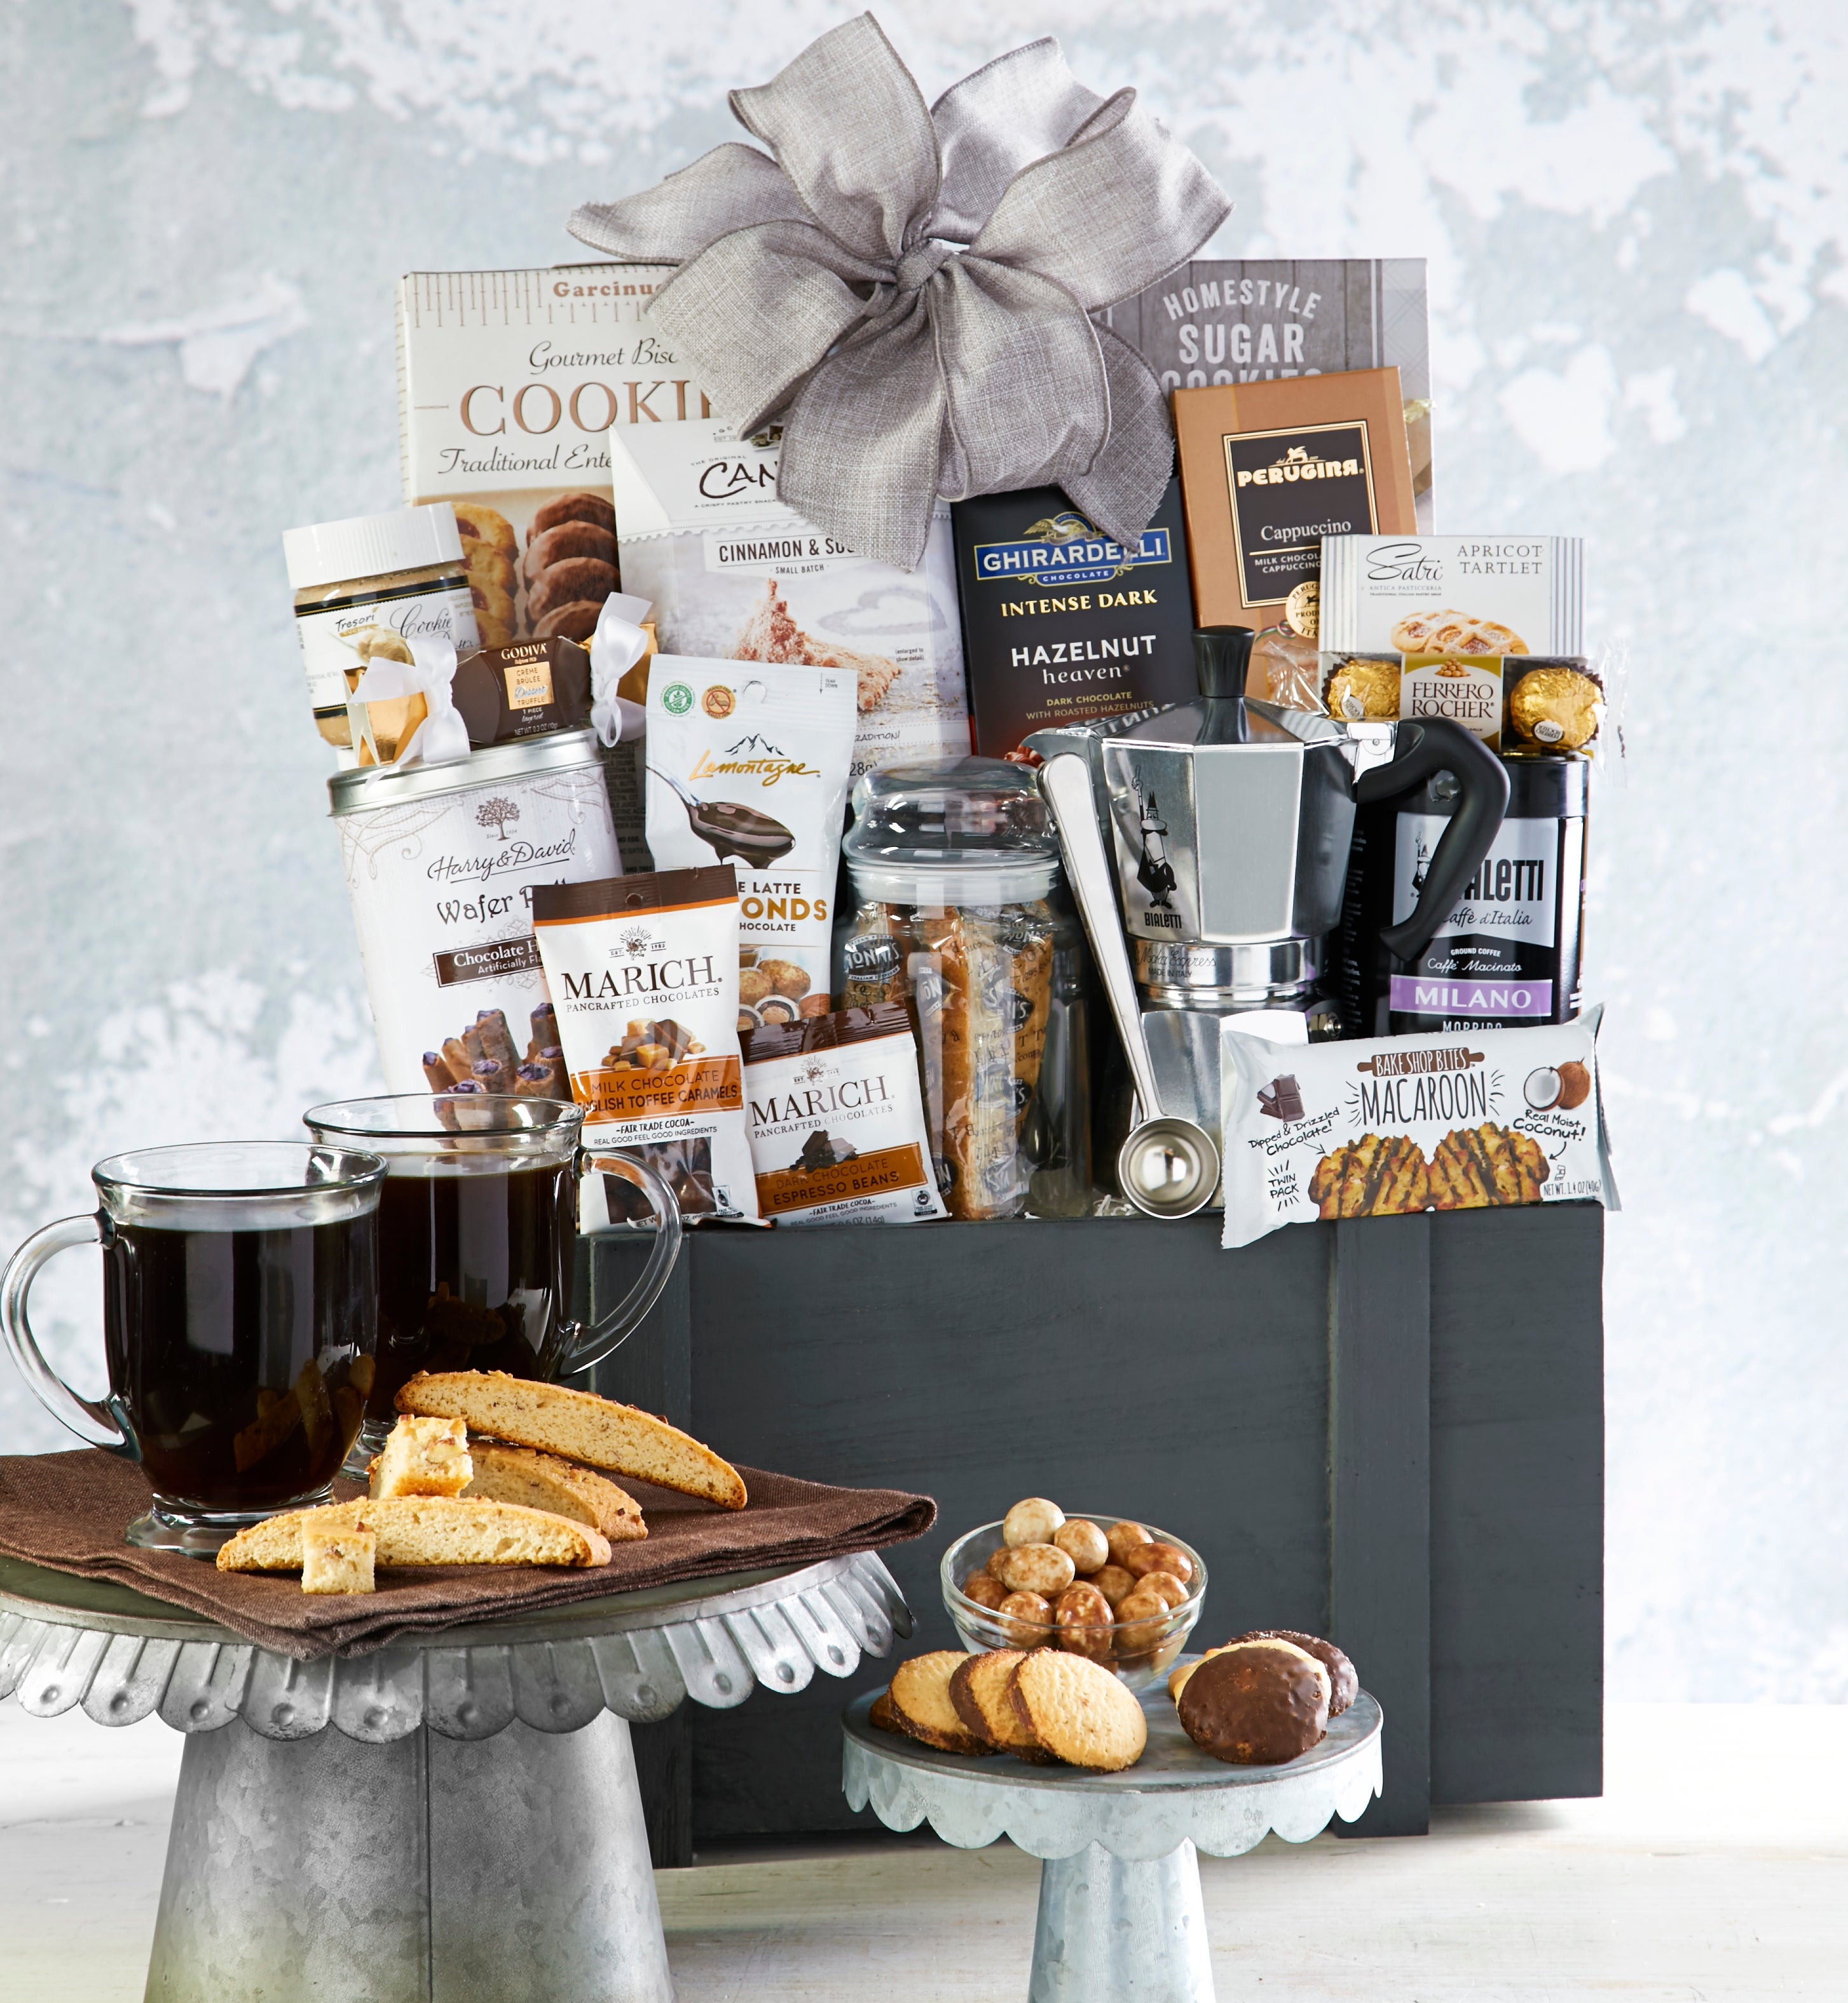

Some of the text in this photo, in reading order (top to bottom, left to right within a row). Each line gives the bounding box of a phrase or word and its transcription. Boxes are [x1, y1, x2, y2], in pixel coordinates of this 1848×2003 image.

[553, 281, 662, 297] Garcinu
[1163, 279, 1322, 320] HOMESTYLE
[1179, 323, 1304, 364] SUGAR
[530, 341, 624, 374] Gourmet
[438, 444, 559, 474] Traditional
[1237, 459, 1359, 486] PERUGINA
[1261, 519, 1352, 543] Cappuccino
[719, 538, 855, 562] CINNAMON & SU
[1255, 553, 1322, 566] MILK CHOCOL
[1457, 545, 1543, 557] APRICOT
[776, 563, 824, 574] SMALL BATCH
[1043, 570, 1109, 582] CHOCOLATE
[1460, 561, 1543, 574] TARTLET
[1001, 589, 1158, 617] INTENSE DARK
[336, 614, 374, 631] Tresori
[501, 644, 547, 660] GODIVA
[1011, 635, 1156, 667] HAZELNUT
[1043, 666, 1122, 684] heaven
[514, 685, 547, 699] Dessert
[1046, 691, 1132, 706] DARK CHOCOLATE
[1412, 682, 1493, 699] FERRERO
[517, 696, 545, 705] TRUFFLE
[1026, 700, 1154, 720] WITH ROASTED HAZELNUTS
[1412, 700, 1493, 718] ROCHER
[689, 750, 820, 787] Lamontagne
[753, 882, 801, 894] LATTE
[437, 895, 512, 925] Wafer
[741, 897, 827, 921] ONDS
[739, 922, 796, 931] HOCOLATE
[454, 946, 524, 967] Chocolate
[1451, 947, 1501, 957] GROUND COFFEE
[478, 957, 526, 974] Artificially
[1149, 968, 1165, 976] MADE
[1461, 959, 1522, 973] Macinato
[561, 956, 716, 1000] MARICH
[566, 988, 719, 1012] PANCRAFTED CHOCOLATES
[1415, 986, 1531, 1008] MILANO
[1376, 1048, 1466, 1076] BAKE SHOP BITES
[592, 1070, 719, 1094] MILK CHOCOLATE
[629, 1085, 737, 1108] TOFFEE CARAMELS
[749, 1075, 889, 1127] MARICH
[1362, 1071, 1486, 1125] MACAROON
[639, 1120, 663, 1131] TRADE
[755, 1104, 893, 1139] PANCRAFTED CHOCOLATES
[1248, 1107, 1339, 1149] Dipped & Drizzled
[1525, 1110, 1581, 1127] Real Moist
[612, 1135, 633, 1143] GOOD
[675, 1126, 717, 1136] INGREDIENTS
[1266, 1120, 1332, 1155] Chocolate!
[1513, 1118, 1585, 1141] Coconut!
[776, 1159, 888, 1189] DARK CHOCOLATE
[1268, 1174, 1296, 1187] TWIN
[774, 1171, 899, 1205] ESPRESSO BEANS
[1270, 1183, 1299, 1198] PACK
[1543, 1183, 1556, 1195] NET
[1577, 1181, 1585, 1193] OZ
[828, 1203, 849, 1212] TRADE
[840, 1208, 858, 1216] GOOD
[859, 1202, 897, 1213] INGREDIENTS
